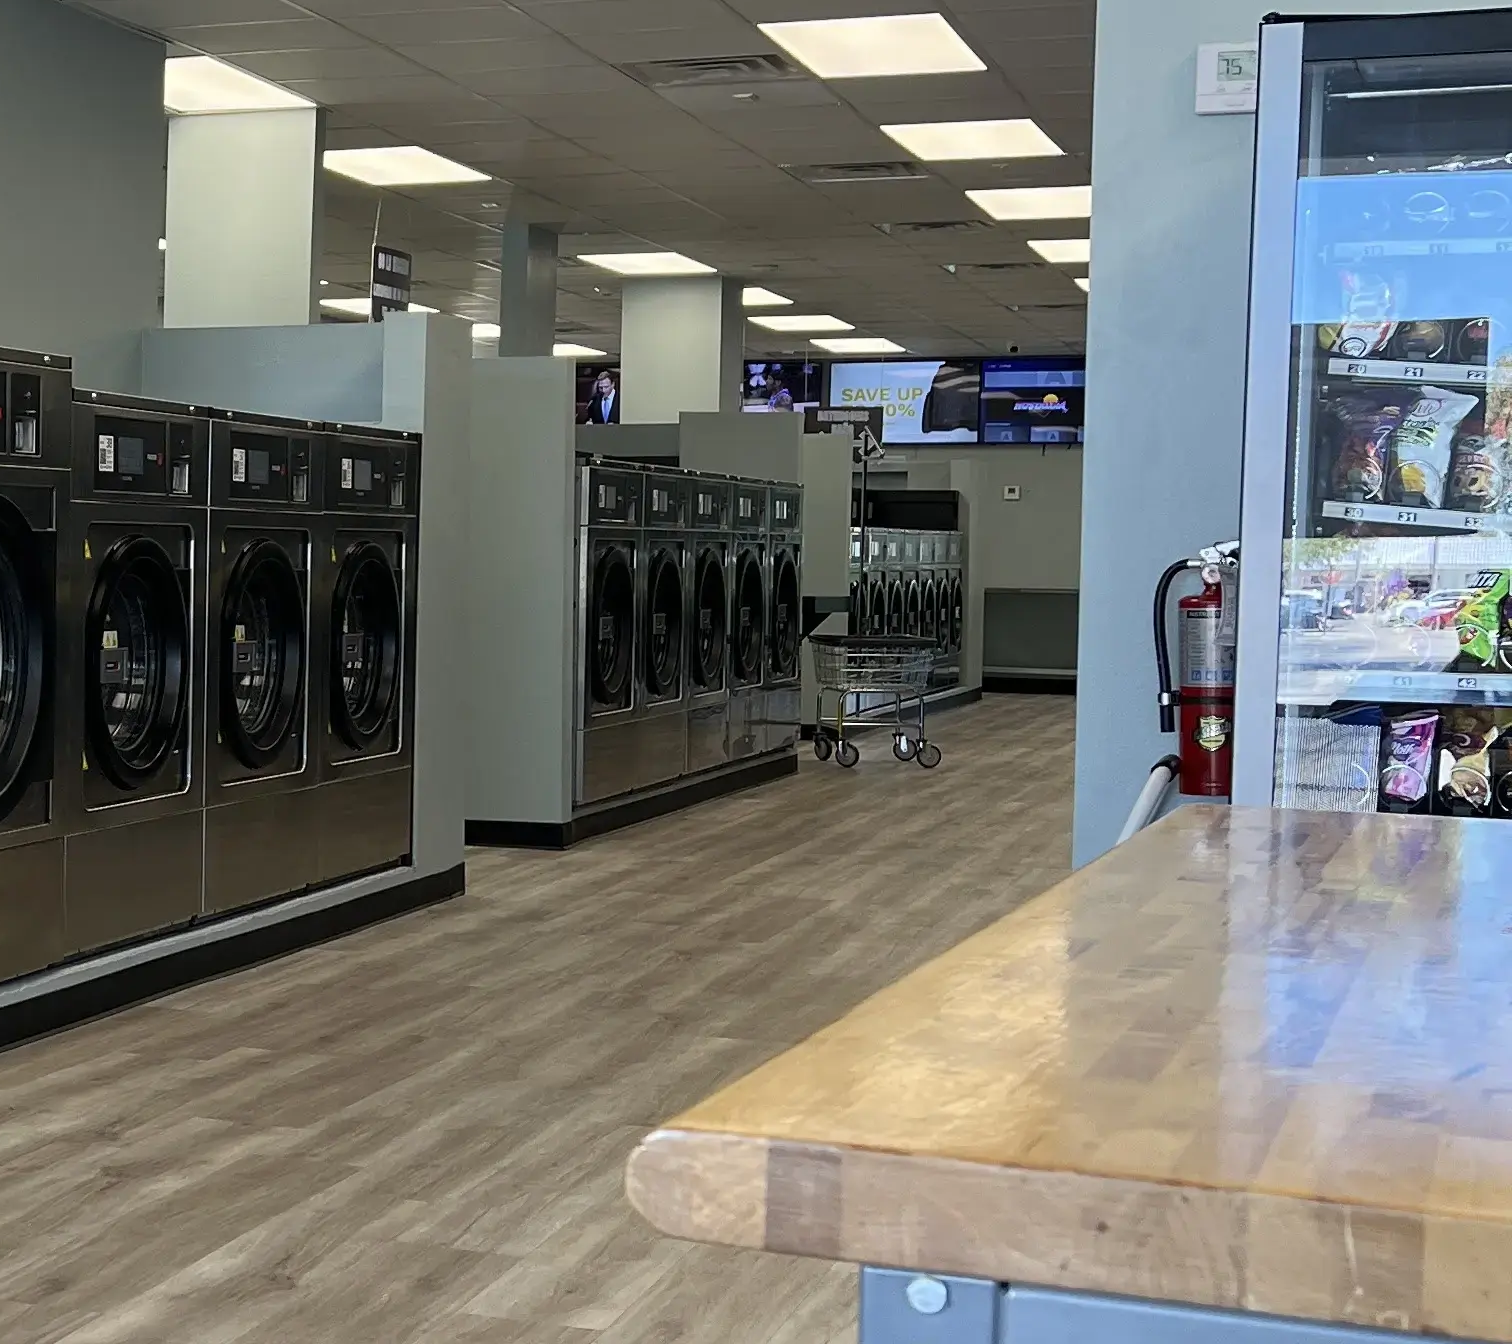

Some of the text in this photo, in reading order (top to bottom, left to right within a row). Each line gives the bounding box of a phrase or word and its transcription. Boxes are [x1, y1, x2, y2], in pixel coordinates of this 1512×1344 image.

[1220, 58, 1242, 75] 75
[1349, 364, 1486, 380] 20 21 22
[841, 388, 923, 402] SAVE UP
[1346, 508, 1484, 527] 30 31 32
[1459, 678, 1476, 688] 42
